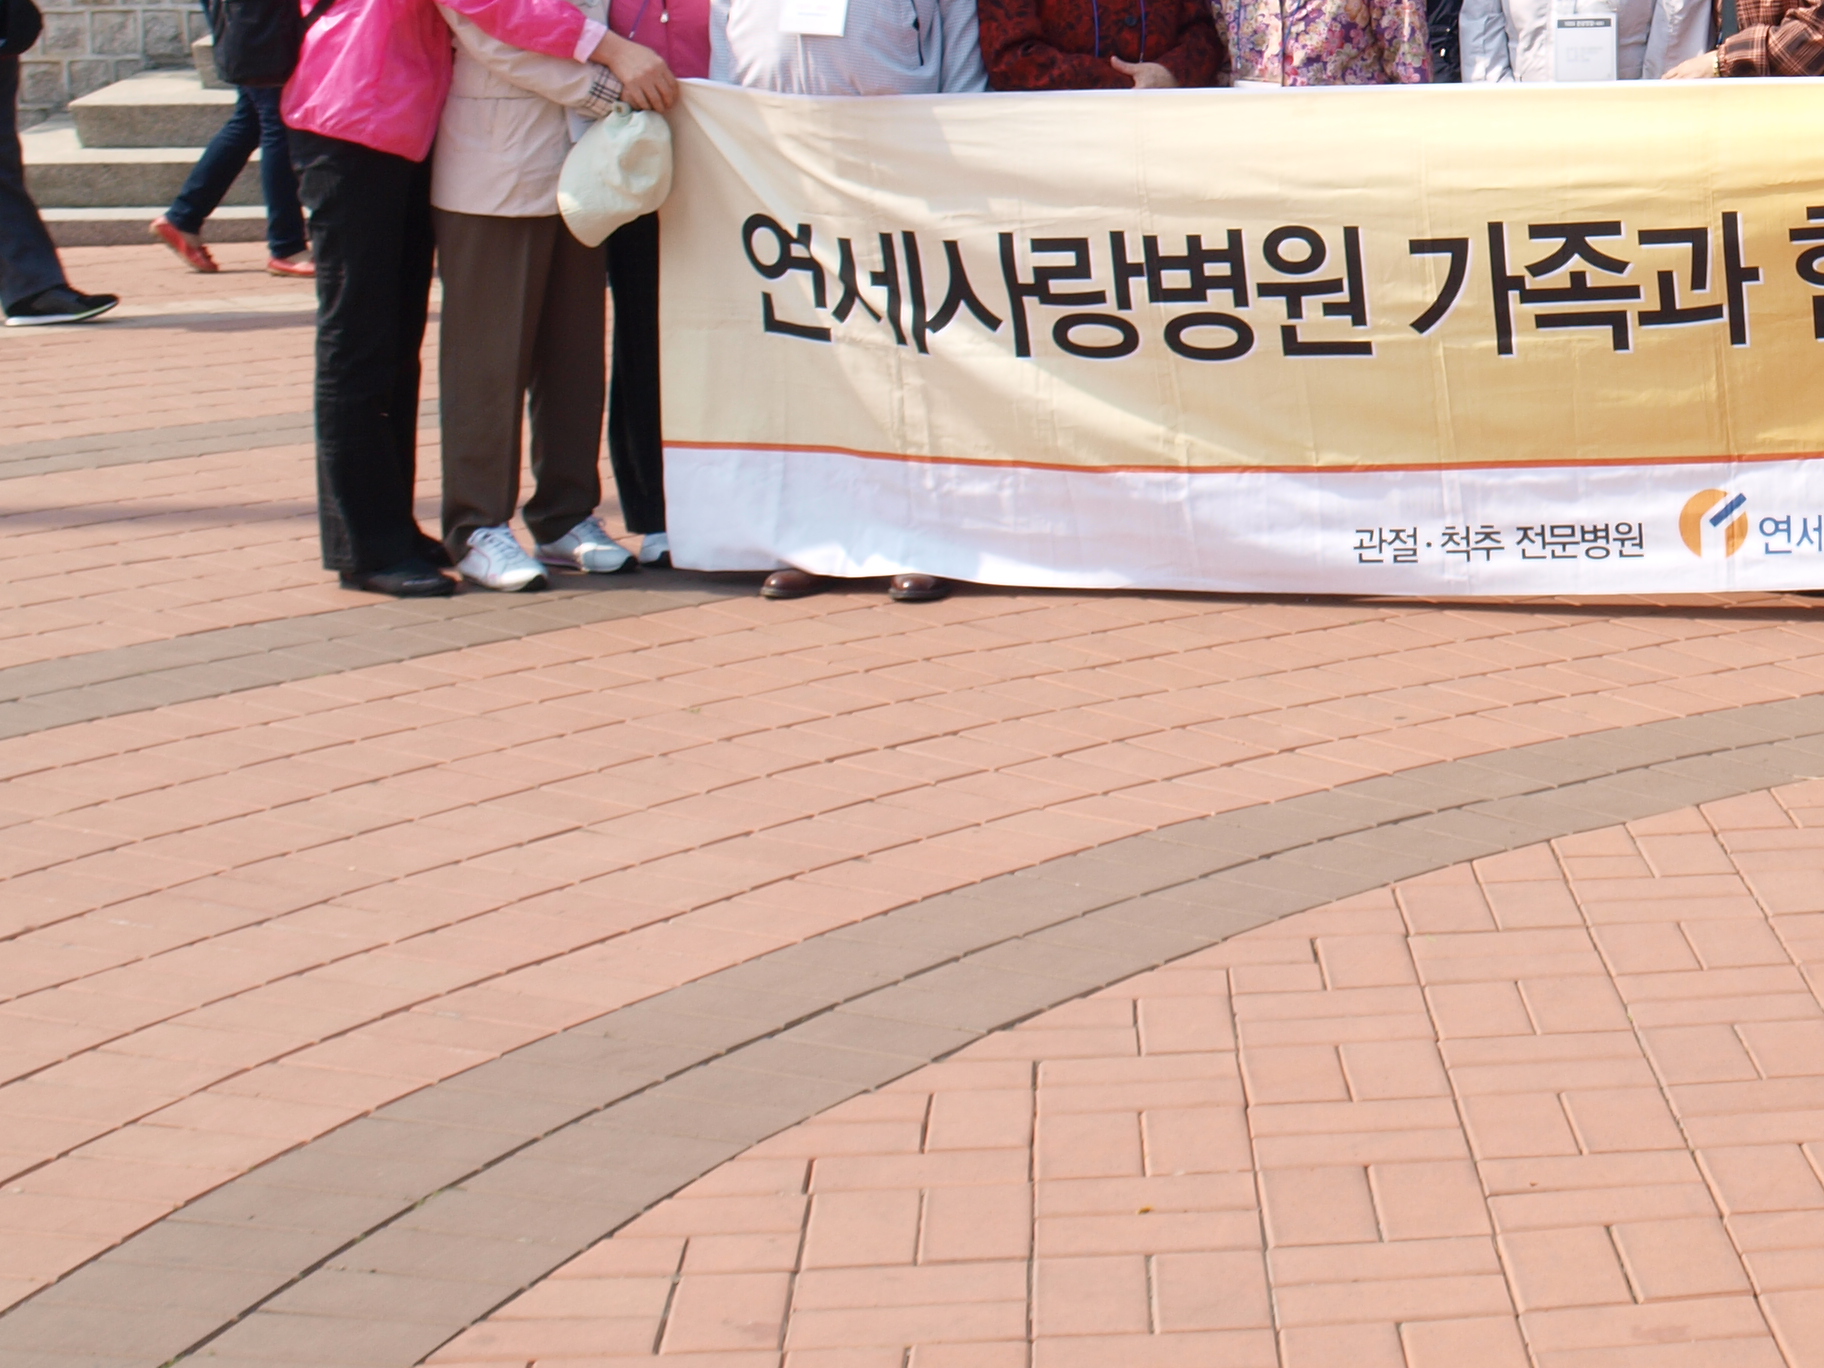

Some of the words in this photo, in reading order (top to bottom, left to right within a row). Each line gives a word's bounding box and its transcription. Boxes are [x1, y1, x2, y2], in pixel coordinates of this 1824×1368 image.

[742, 210, 1374, 362] 연세사랑병원
[1407, 210, 1762, 357] 가족과
[1515, 521, 1646, 561] 전문병원
